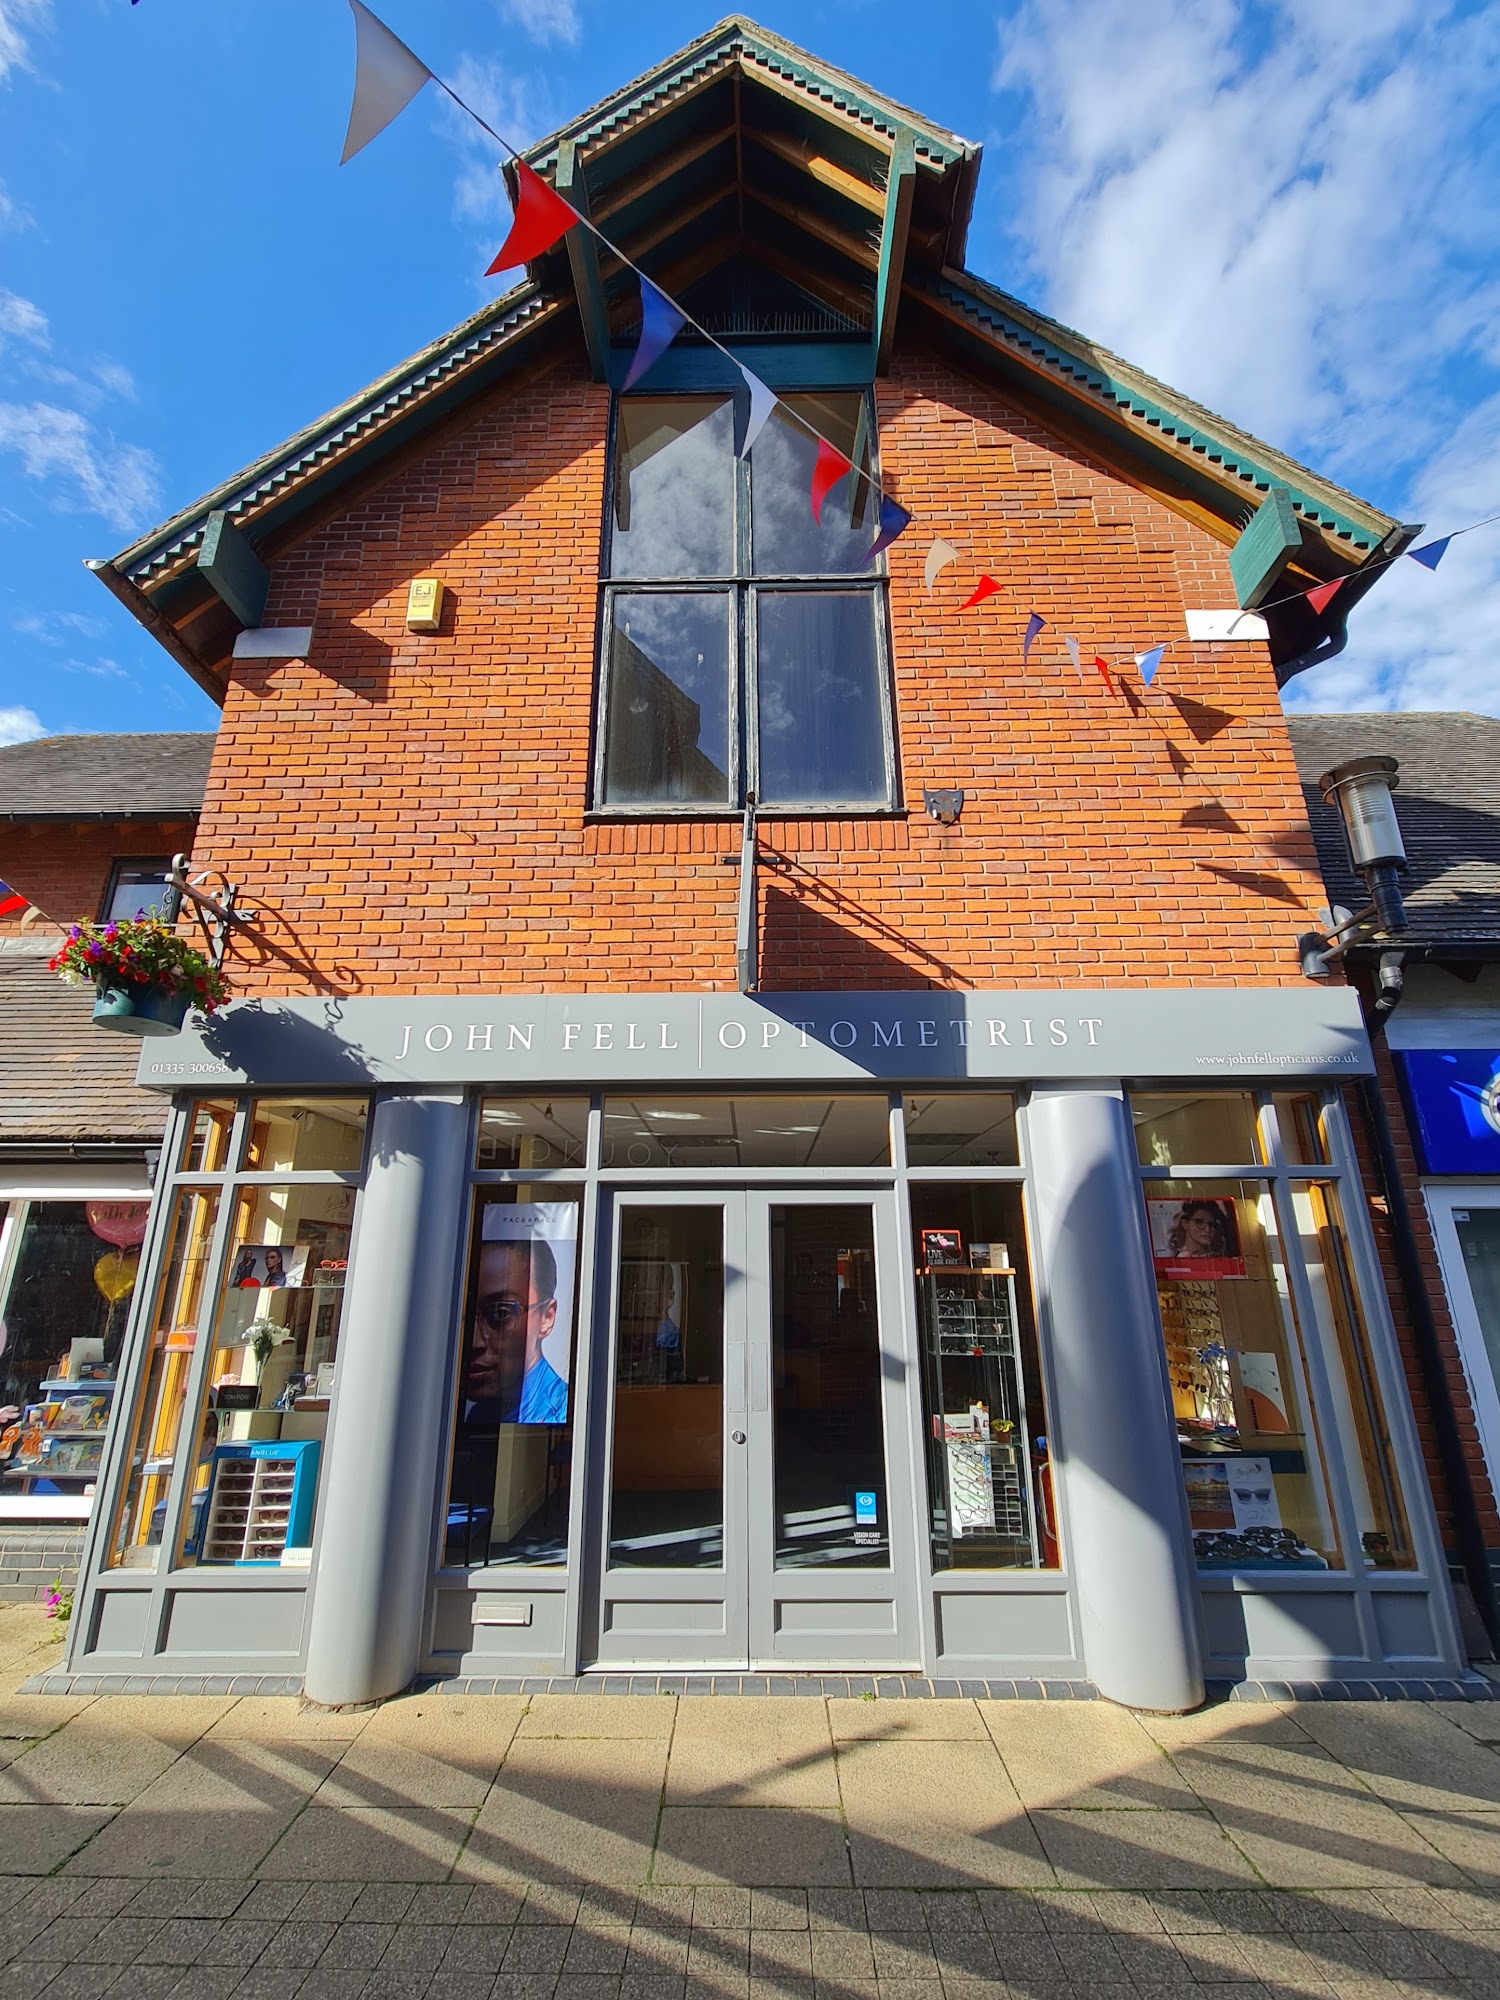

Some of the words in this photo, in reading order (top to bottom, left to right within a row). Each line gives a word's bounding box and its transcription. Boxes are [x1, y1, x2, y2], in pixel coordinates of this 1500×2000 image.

[415, 585, 432, 595] EJ
[717, 1018, 1104, 1049] OPTOMETRIST
[395, 1023, 536, 1060] JOHN
[561, 1022, 679, 1051] FELL
[1195, 1051, 1360, 1068] www.johnfellopticians.co.uk
[151, 1063, 185, 1074] 01335
[188, 1062, 229, 1074] 300658
[927, 1249, 943, 1259] LIVE
